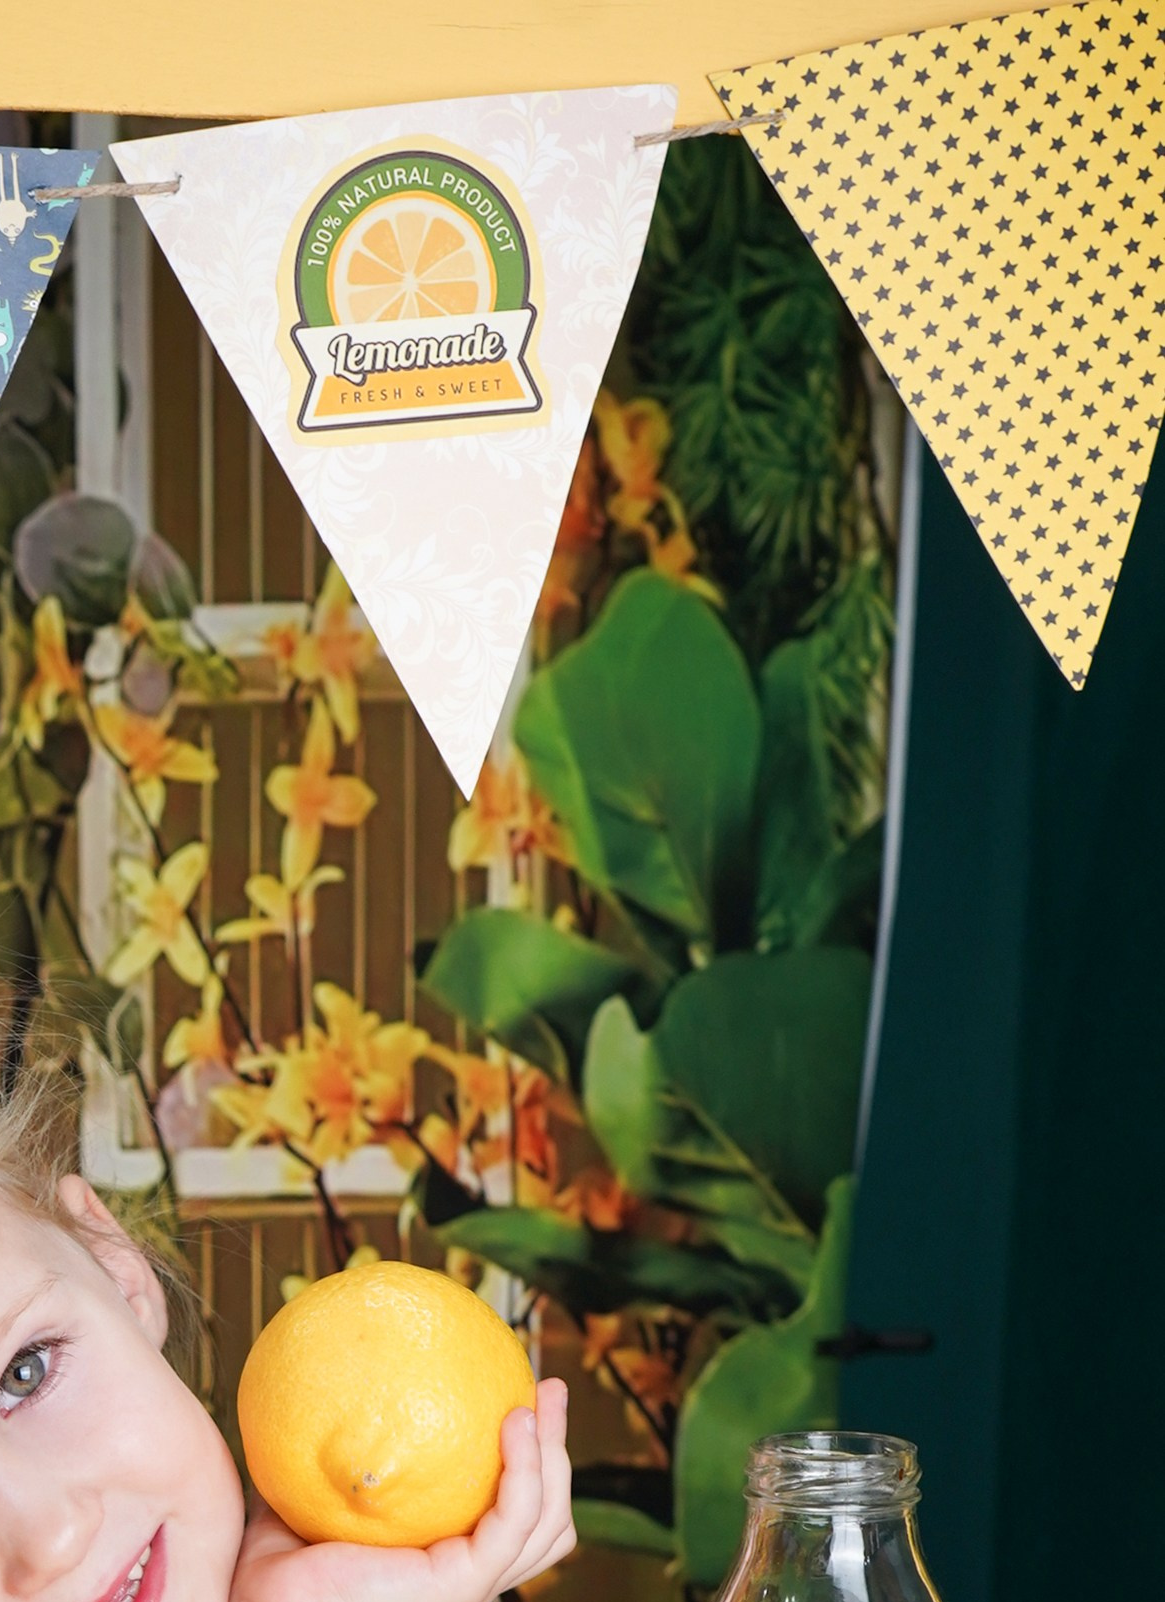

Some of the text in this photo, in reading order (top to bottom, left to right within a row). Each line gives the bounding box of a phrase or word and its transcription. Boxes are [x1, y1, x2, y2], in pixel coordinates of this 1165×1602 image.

[307, 166, 516, 267] 100% NATURAL PRODUCT
[328, 323, 507, 386] Lemonade
[340, 378, 503, 404] FRESH & SWEET
